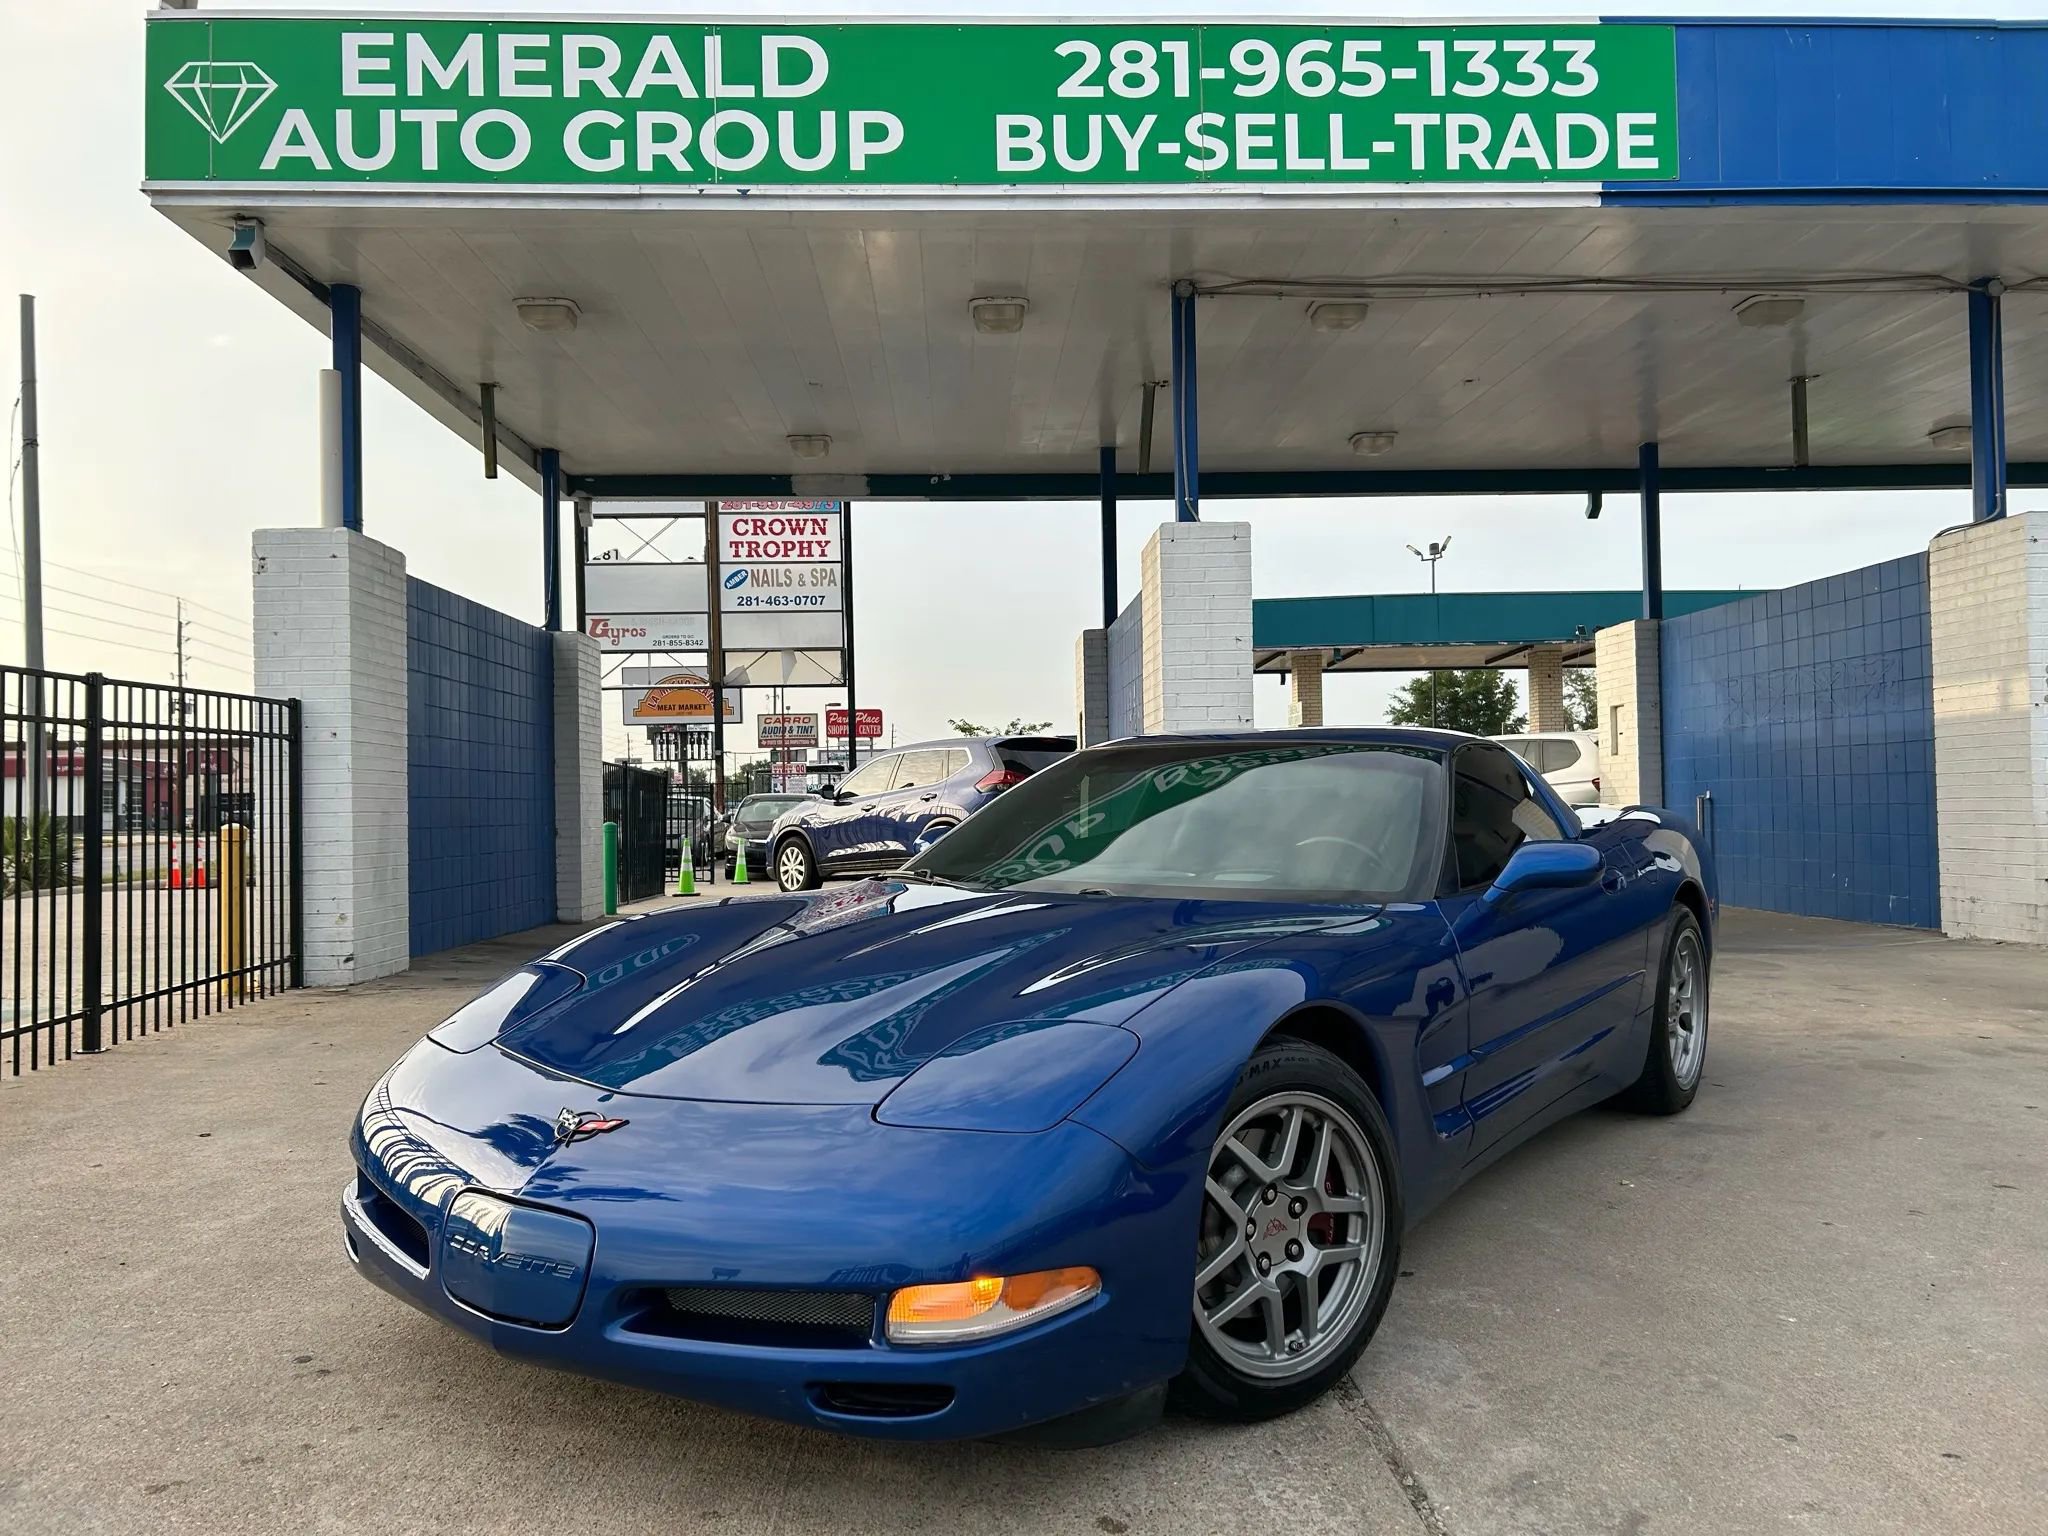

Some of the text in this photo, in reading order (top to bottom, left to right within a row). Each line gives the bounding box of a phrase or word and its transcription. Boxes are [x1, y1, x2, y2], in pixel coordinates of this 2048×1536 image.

[341, 32, 830, 99] EMERALD
[1055, 40, 1599, 98] 281-965-1333
[259, 109, 904, 172] AUTO GROUP
[996, 112, 1659, 172] BUY-SELL-TRADE
[732, 518, 828, 536] CROWN
[729, 540, 831, 558] TROPHY
[725, 568, 838, 589] AMBER NAILS & SPA
[737, 595, 826, 606] 281-463-0707
[589, 618, 647, 646] Gyros
[647, 695, 660, 709] LA
[678, 703, 706, 711] MARKET
[764, 716, 811, 724] CARRO
[829, 712, 880, 723] Par Place
[762, 725, 814, 735] AUDIO & TINT
[859, 725, 881, 735] CENTER
[449, 1234, 576, 1279] CORVETTE
